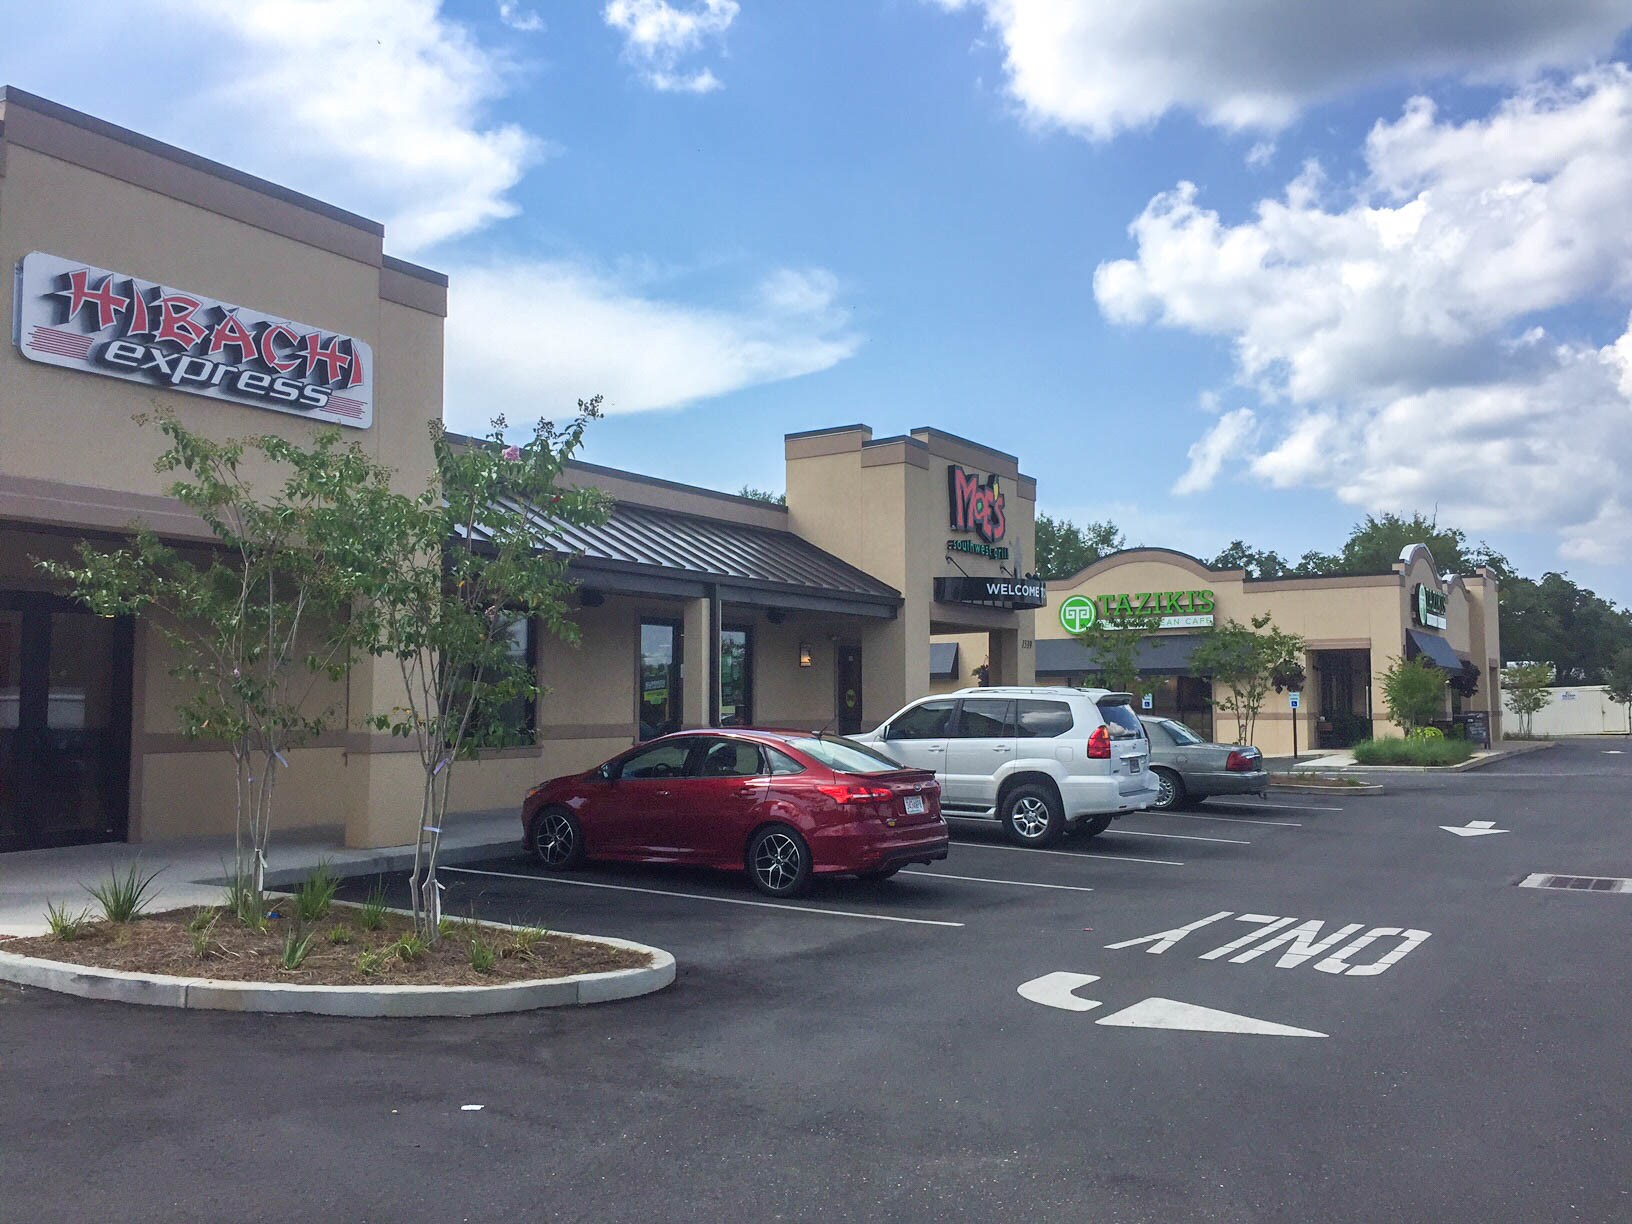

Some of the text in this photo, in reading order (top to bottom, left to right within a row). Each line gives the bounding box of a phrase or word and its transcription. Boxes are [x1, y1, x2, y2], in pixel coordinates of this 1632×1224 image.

[62, 268, 365, 388] HIBACHI
[104, 338, 333, 408] express
[986, 583, 1040, 598] WELCOME
[1097, 590, 1215, 616] TAZIKI'S
[1104, 911, 1433, 976] ONLY
